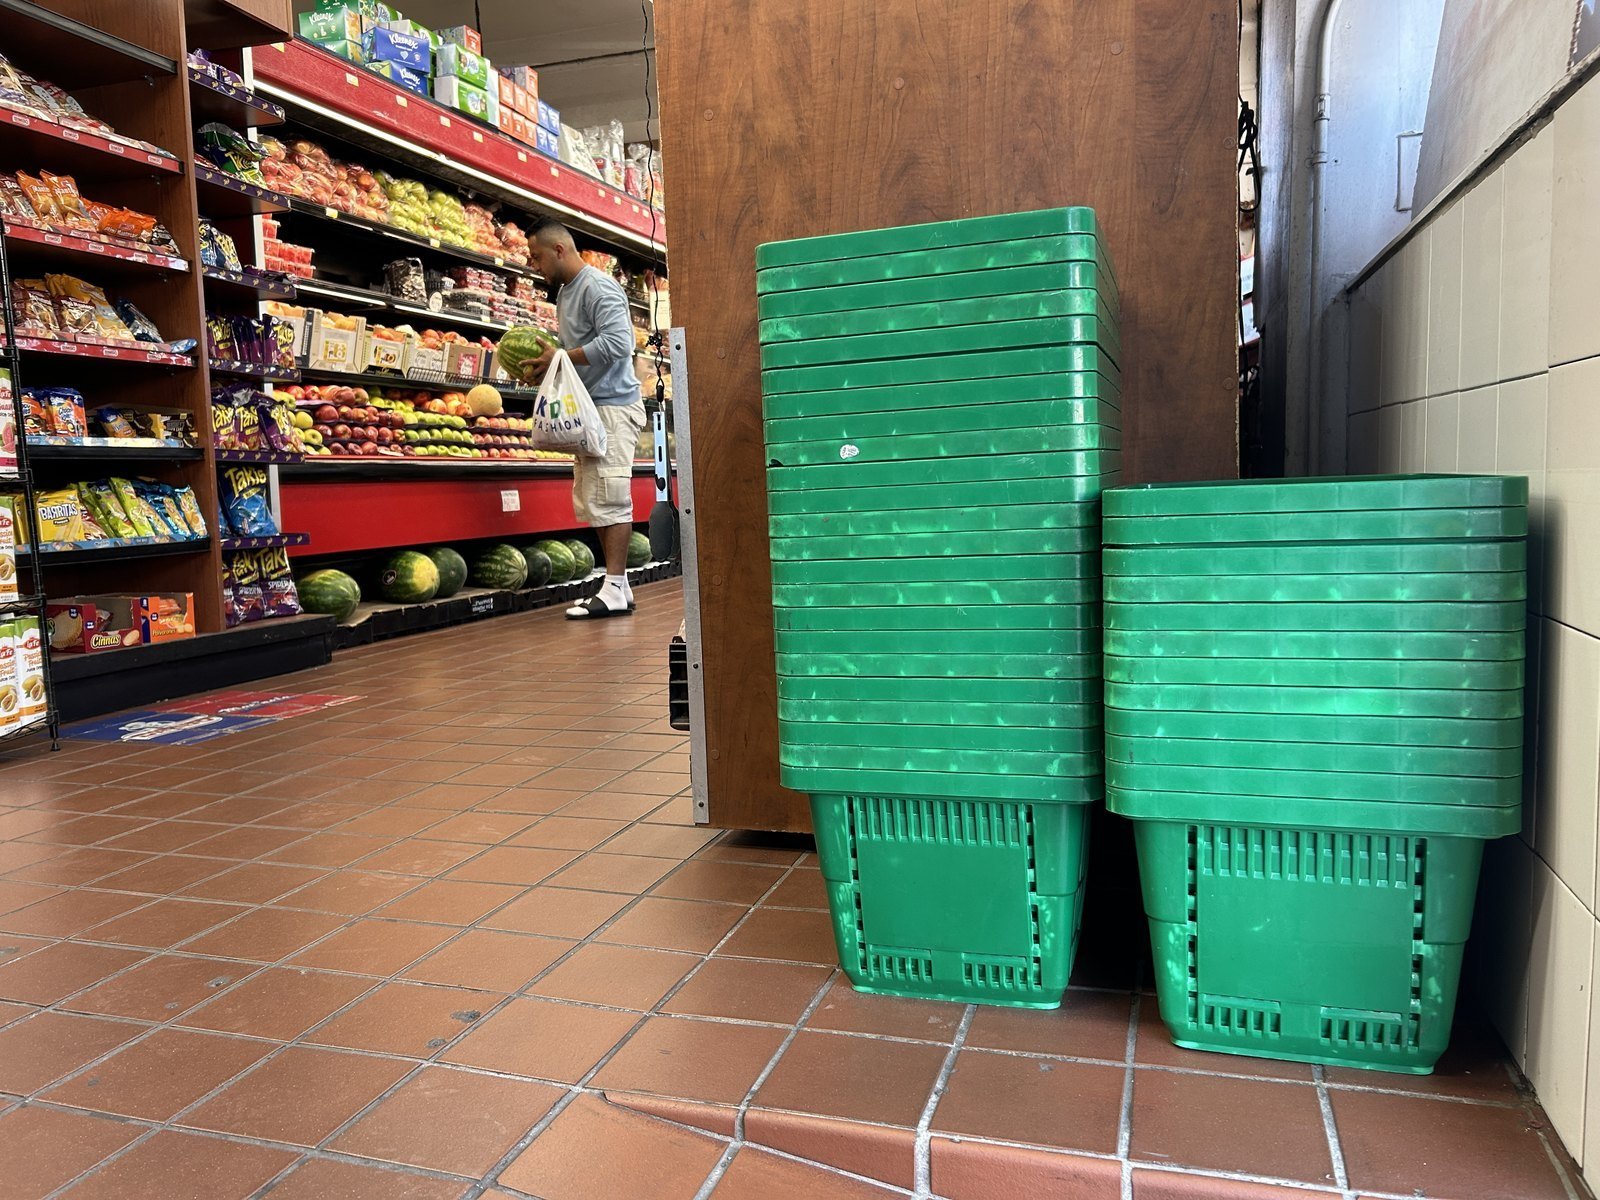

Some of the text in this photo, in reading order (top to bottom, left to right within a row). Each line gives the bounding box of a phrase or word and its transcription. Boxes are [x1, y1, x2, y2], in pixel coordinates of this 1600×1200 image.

[308, 12, 334, 25] Kleenex
[388, 33, 419, 49] Kleenex
[399, 67, 421, 85] Kleenex
[533, 418, 582, 432] FASHION
[225, 466, 267, 498] Takis
[39, 503, 78, 520] BARRITAS
